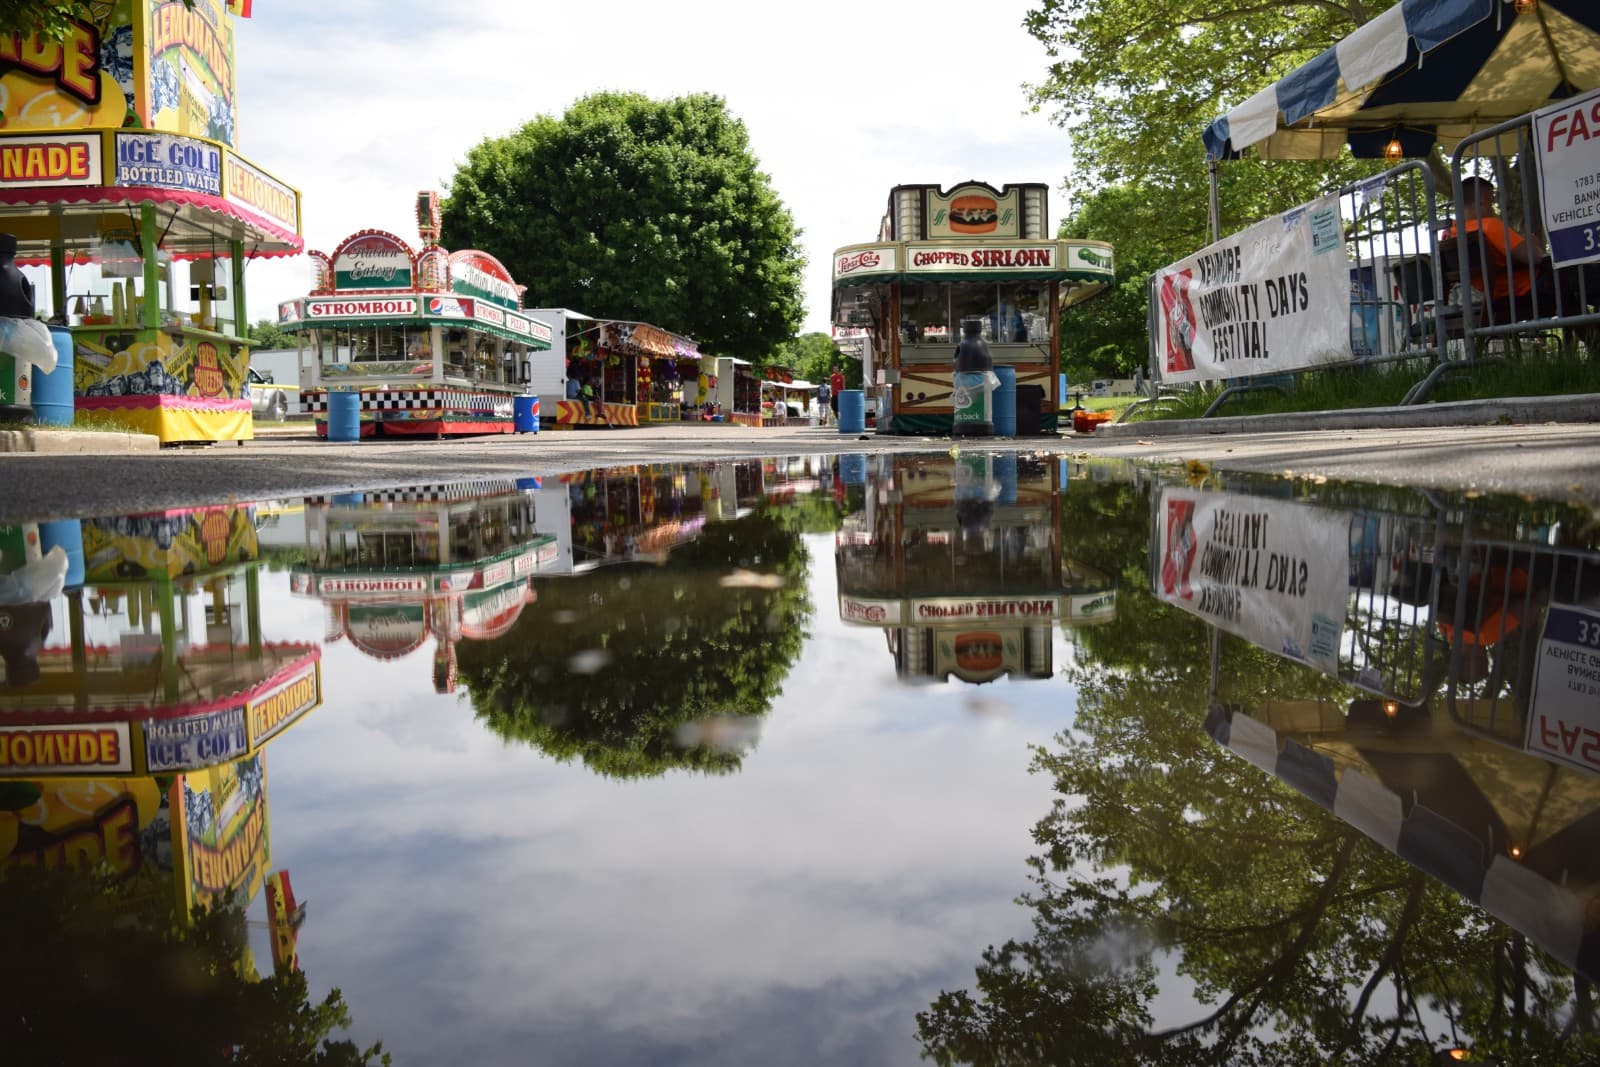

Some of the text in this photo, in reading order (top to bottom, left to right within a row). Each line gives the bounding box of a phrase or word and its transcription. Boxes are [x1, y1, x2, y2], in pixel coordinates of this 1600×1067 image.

[0, 18, 99, 102] DE
[152, 3, 232, 105] LEMONADE
[0, 143, 89, 181] NADE
[120, 136, 220, 174] ICE COLD
[121, 166, 220, 192] BOTTLED WATER
[1574, 175, 1594, 189] 1783
[229, 161, 295, 226] LEMONADE
[1574, 189, 1600, 205] BANN
[1552, 206, 1594, 224] VEHICLE
[350, 261, 396, 281] Eatery
[914, 250, 1050, 267] CHOPPED SIRLOIN
[312, 301, 412, 316] STROMBOLI
[1199, 272, 1309, 330] COMMUNITY DAYS
[510, 316, 526, 330] PIZZA
[1212, 321, 1269, 363] FESTIVAL
